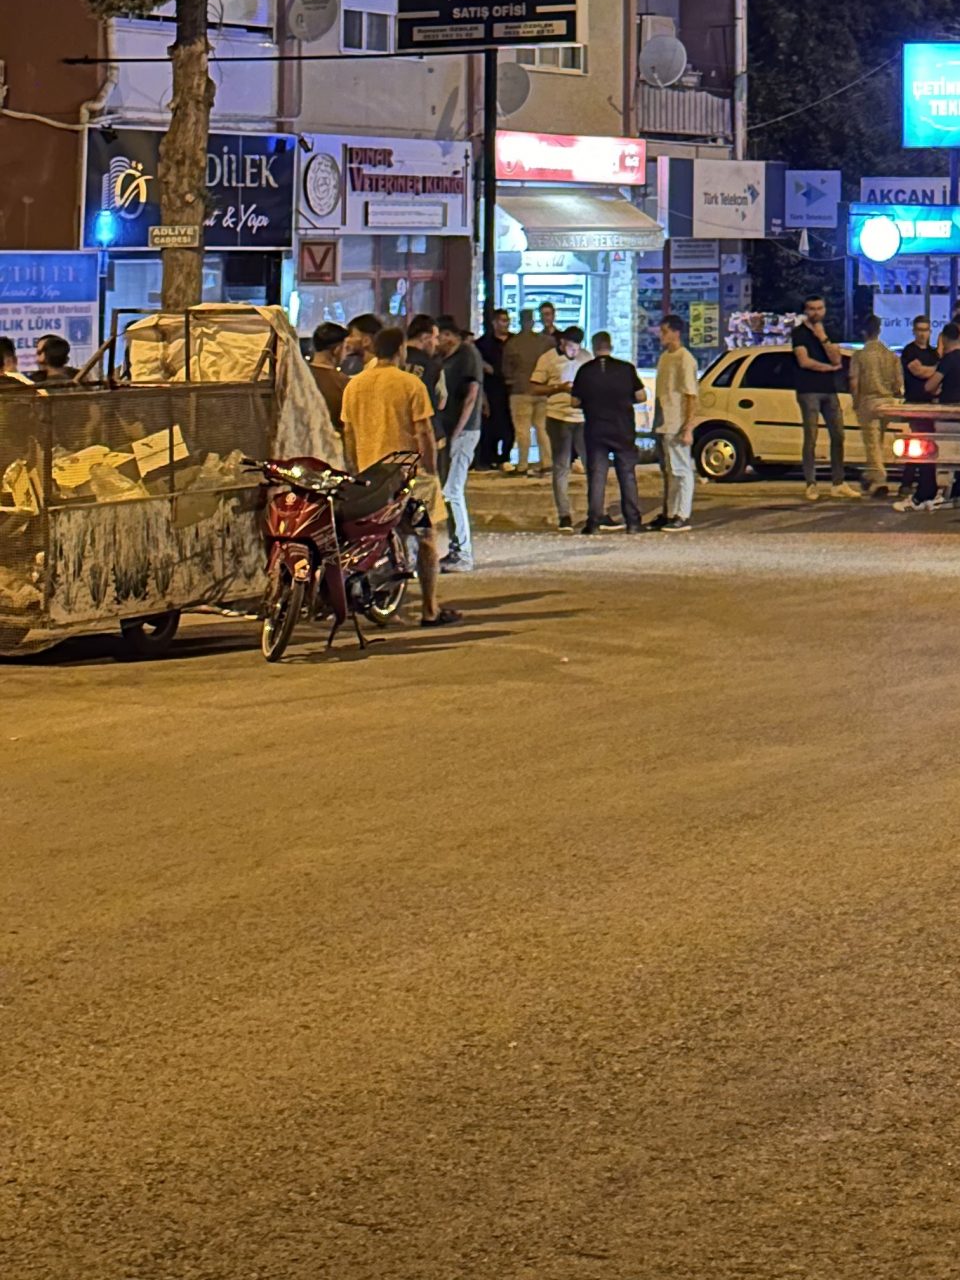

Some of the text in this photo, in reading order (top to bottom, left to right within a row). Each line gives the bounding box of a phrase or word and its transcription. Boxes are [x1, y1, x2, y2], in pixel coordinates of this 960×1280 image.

[452, 2, 527, 20] SATIŞ OFİSİ
[205, 145, 279, 189] DİLEK
[703, 191, 748, 206] Türk Telekom
[866, 188, 935, 205] AKCAN
[152, 225, 194, 236] ADLİYE
[28, 315, 62, 331] LÜKS
